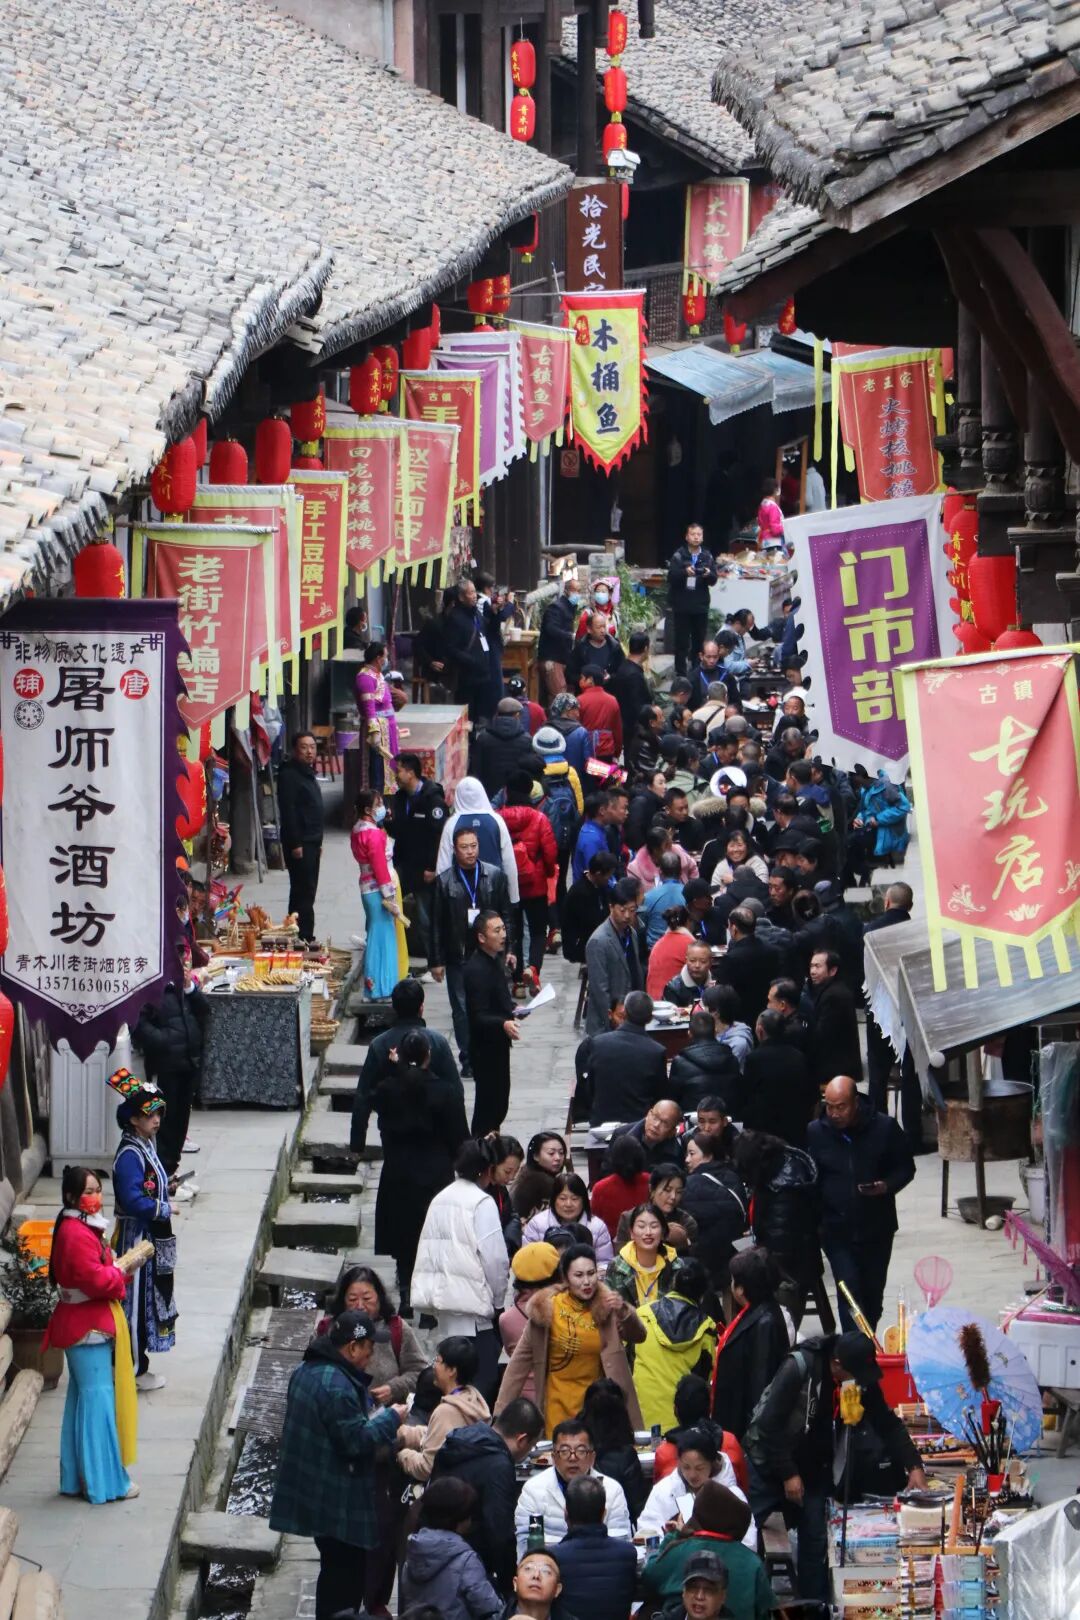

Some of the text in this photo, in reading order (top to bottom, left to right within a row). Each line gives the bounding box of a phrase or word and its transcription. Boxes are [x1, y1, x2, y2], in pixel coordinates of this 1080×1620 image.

[517, 104, 529, 135] 青木川
[368, 368, 380, 407] 青木川
[528, 345, 556, 427] 古镇鱼乡
[590, 319, 620, 435] 木桶鱼
[863, 372, 914, 393] 老王家
[301, 501, 327, 605] 手工豆腐干
[838, 545, 915, 724] 门市部
[14, 641, 146, 664] 非物质文化遗产
[122, 671, 149, 696] 唐
[978, 679, 1033, 705] 古镇
[46, 666, 116, 947] 屠师爷酒坊
[968, 715, 1049, 901] 古玩店
[16, 954, 148, 974] 青木川老街烟馆旁
[37, 976, 129, 993] 13571630058
